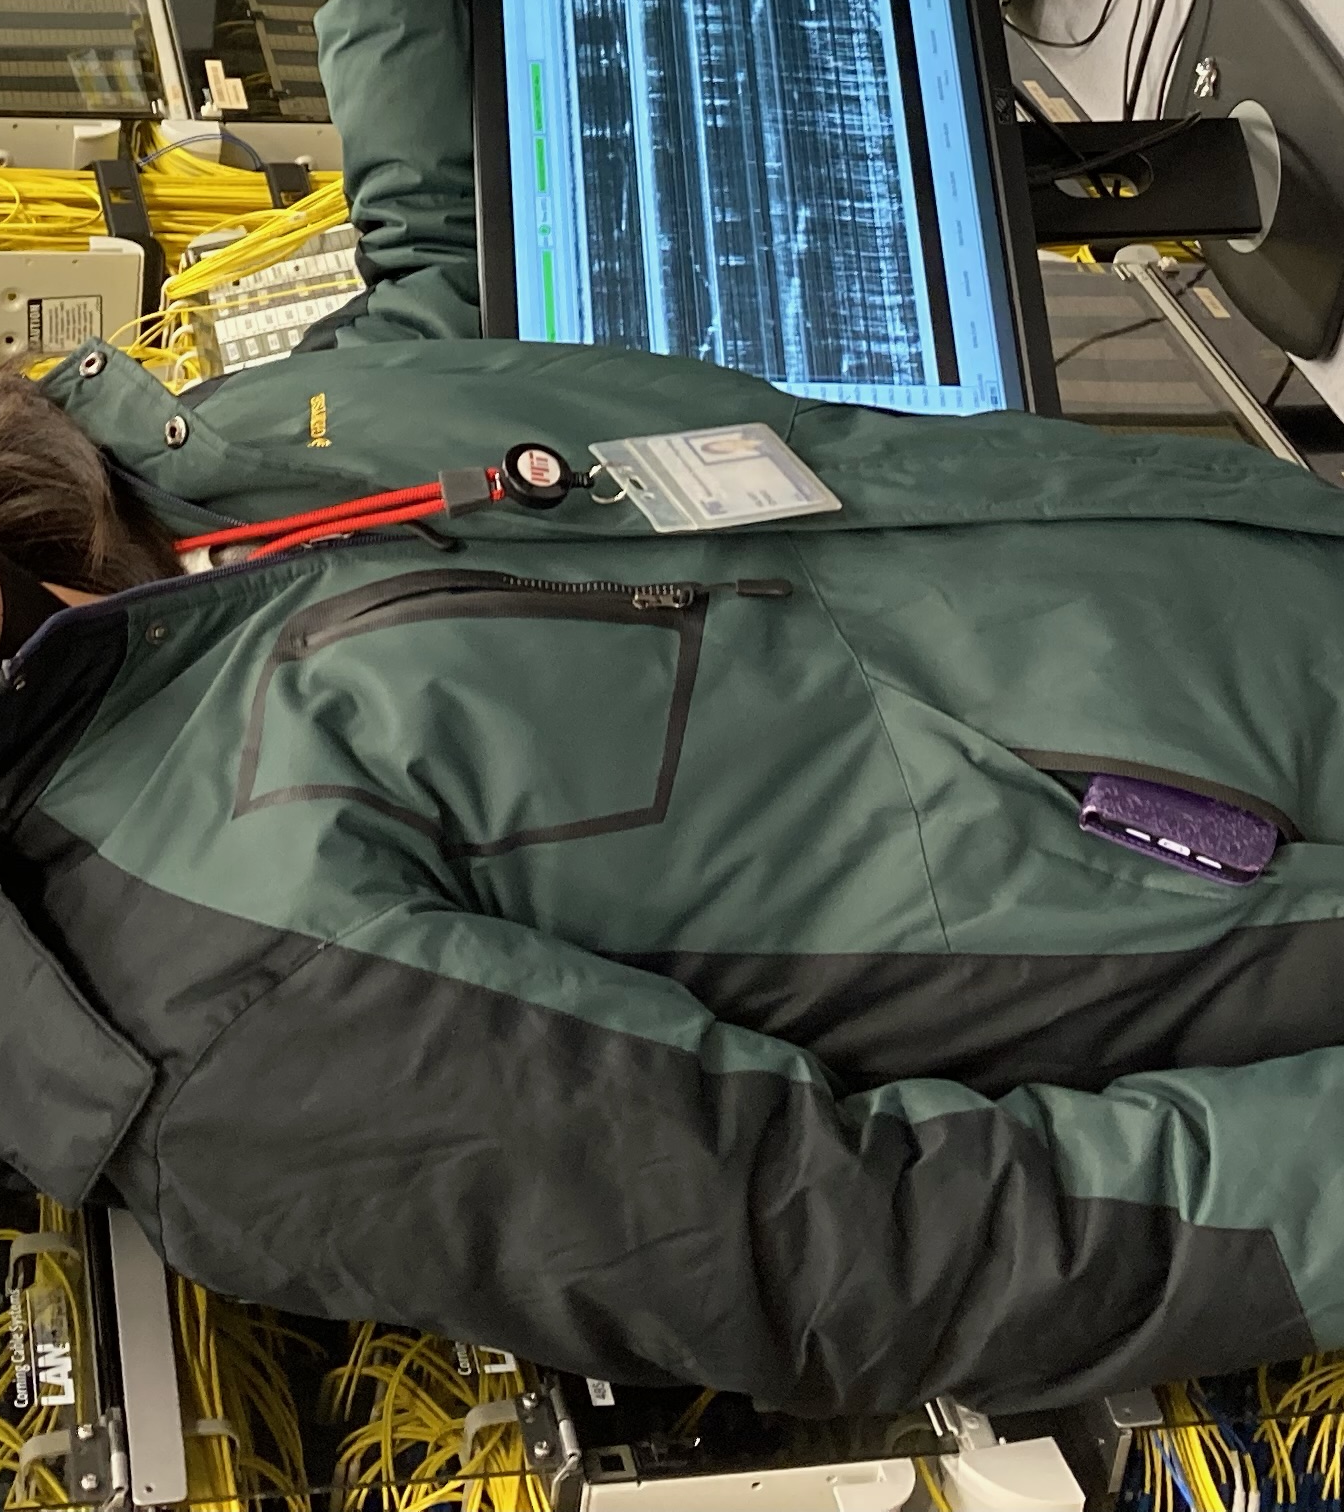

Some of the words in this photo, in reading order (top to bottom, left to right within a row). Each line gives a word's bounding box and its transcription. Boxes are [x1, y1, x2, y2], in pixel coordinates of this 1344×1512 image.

[29, 304, 42, 350] CAUTION
[529, 452, 550, 483] MIT
[8, 1287, 27, 1331] Systems
[10, 1332, 26, 1363] Cable
[13, 1364, 31, 1408] Corning
